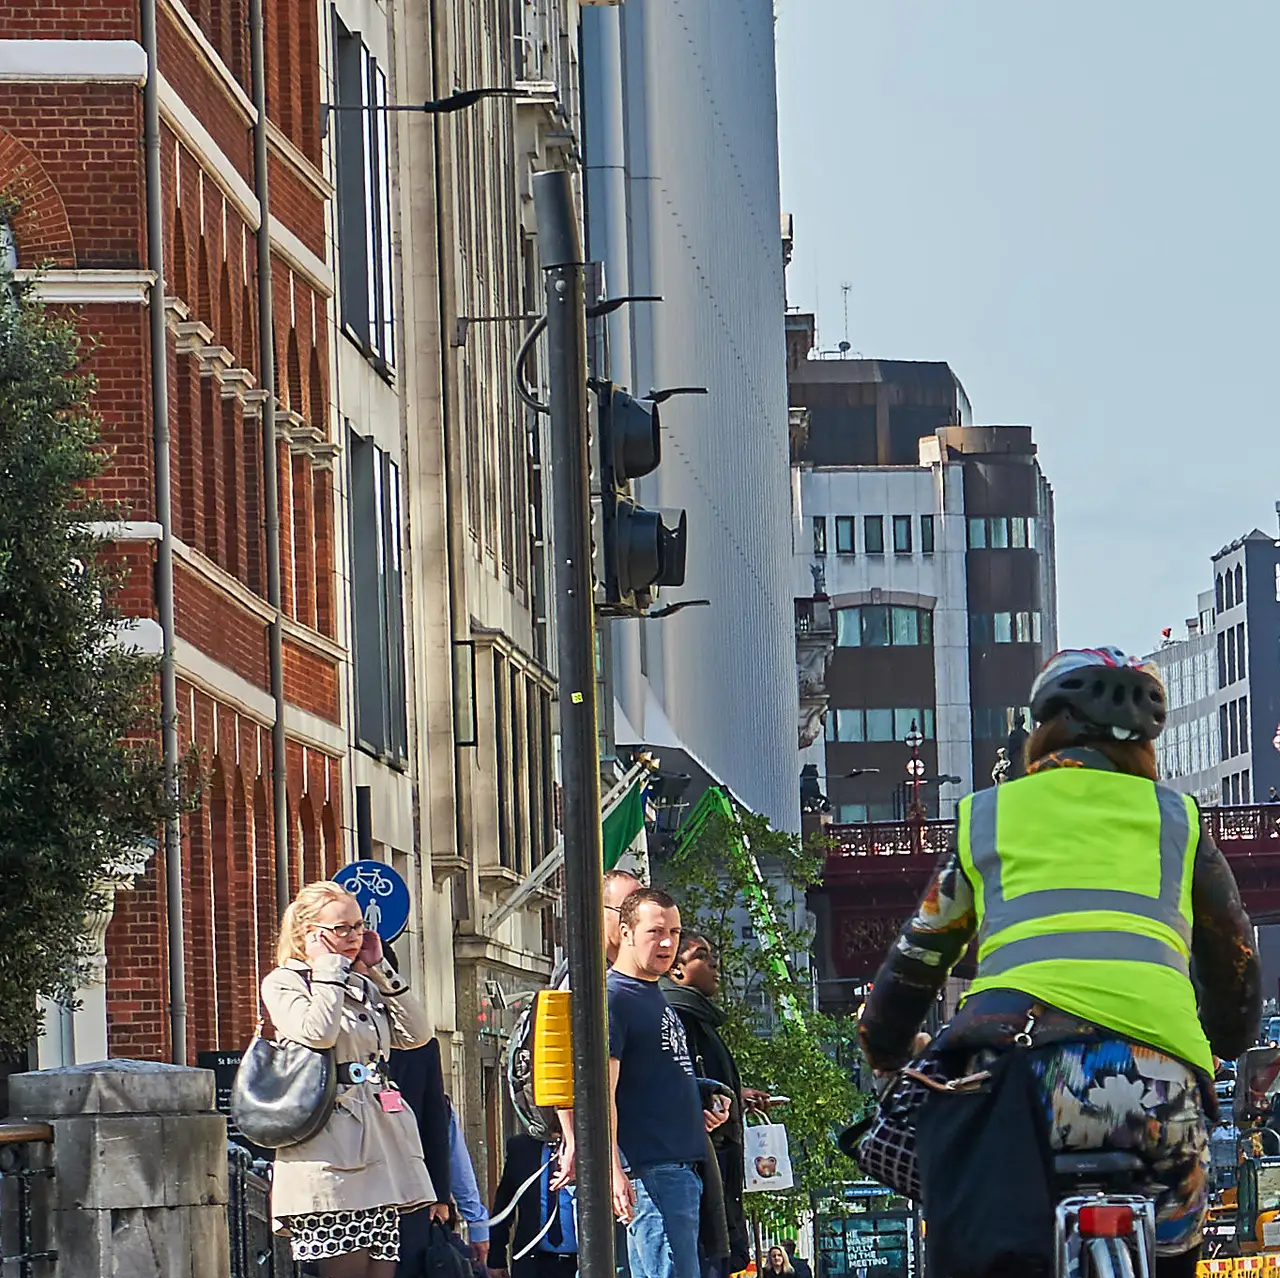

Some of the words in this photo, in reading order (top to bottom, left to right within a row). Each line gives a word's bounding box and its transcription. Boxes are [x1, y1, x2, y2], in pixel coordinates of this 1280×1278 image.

[846, 1229, 858, 1238] HE
[847, 1245, 873, 1253] FULLY
[847, 1252, 858, 1260] IN
[858, 1251, 876, 1259] THE
[849, 1257, 888, 1268] MEETING
